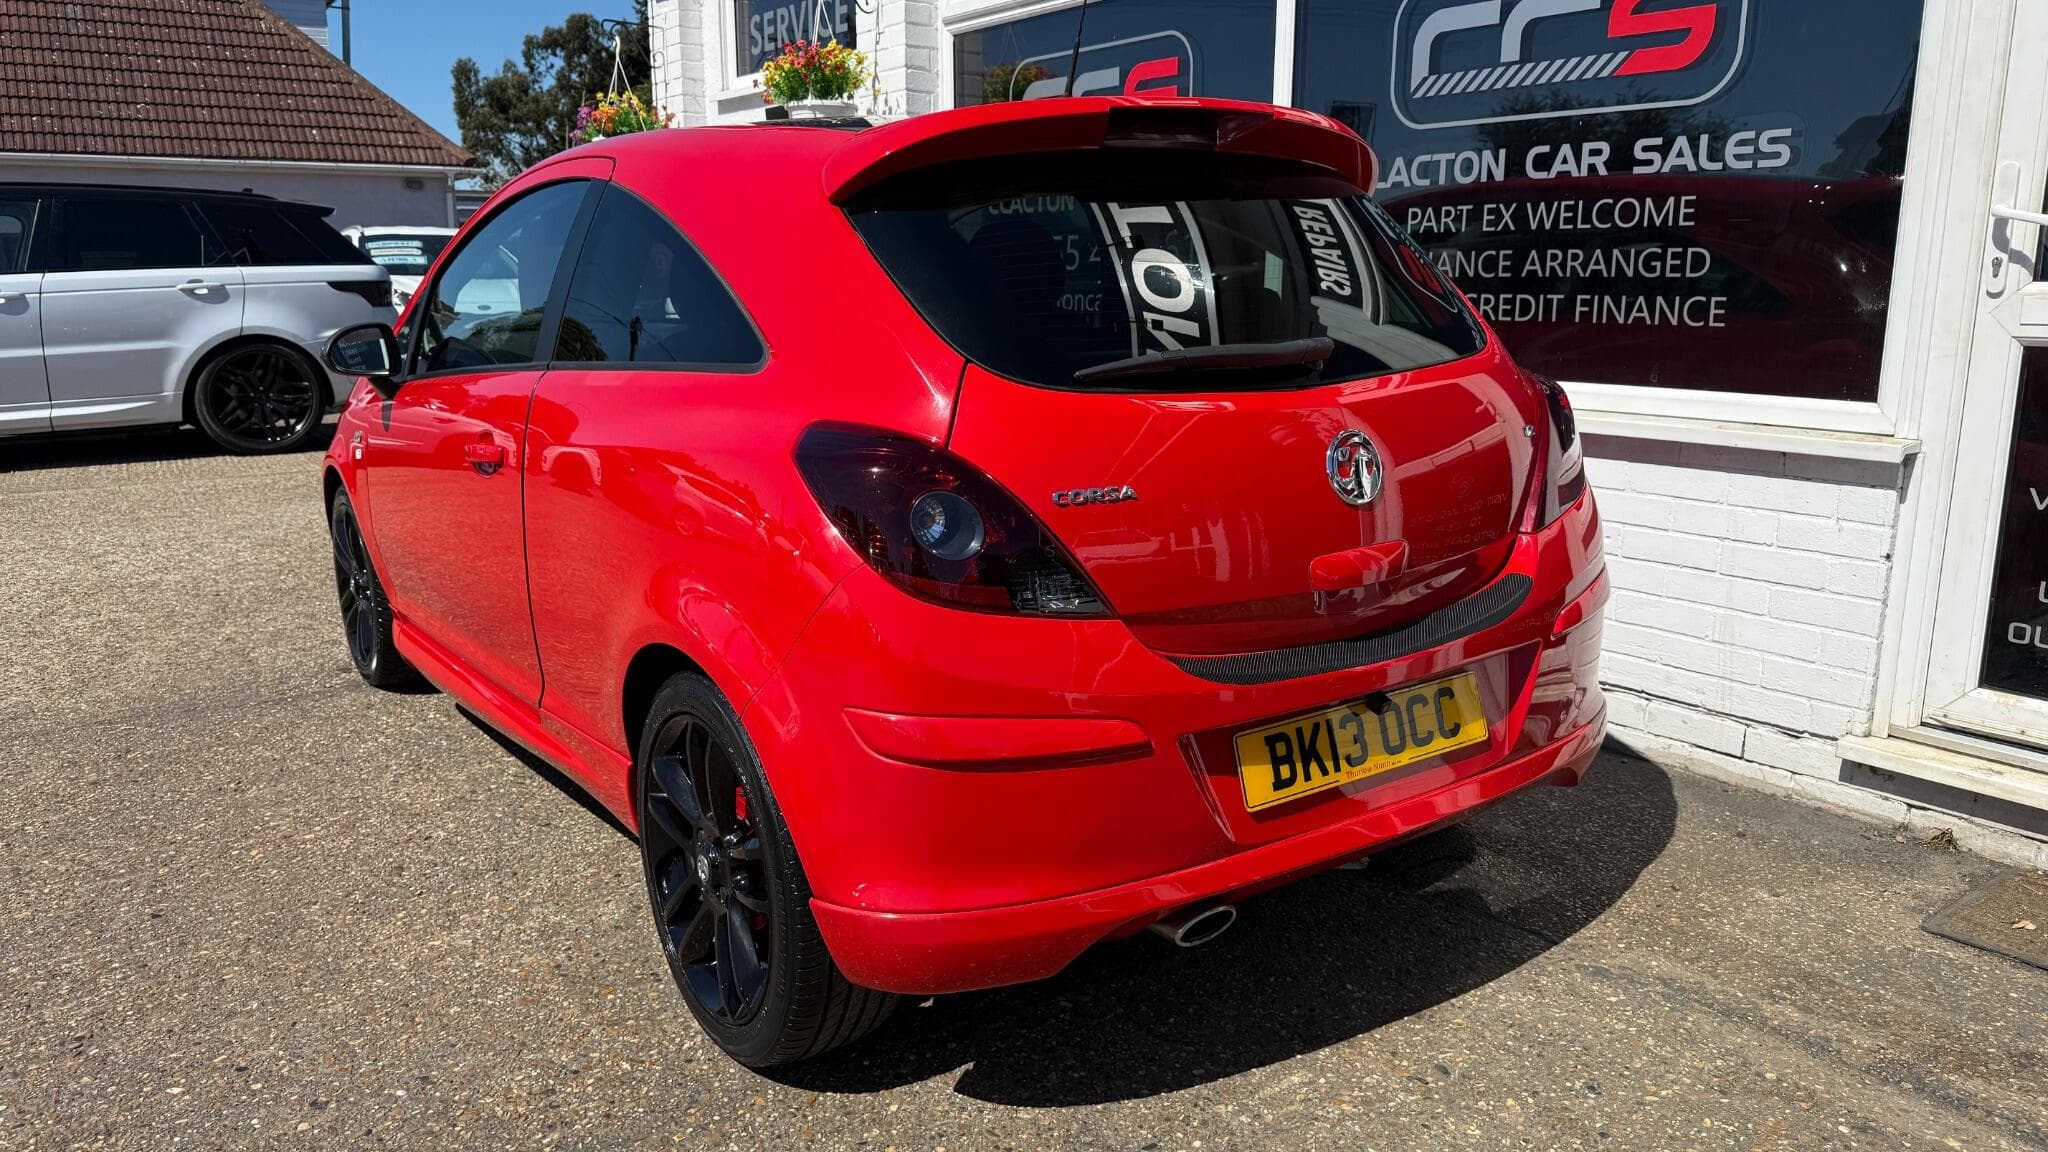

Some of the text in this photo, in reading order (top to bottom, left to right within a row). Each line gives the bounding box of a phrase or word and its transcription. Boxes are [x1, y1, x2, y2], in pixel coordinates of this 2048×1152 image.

[750, 0, 848, 55] SERVICE
[1376, 128, 1792, 188] ACTON CAR SALES
[1407, 195, 1697, 234] PART EX WELCOME
[1429, 247, 1711, 278] ANCE ARRANGED
[1575, 294, 1727, 328] FINANCE
[1052, 485, 1138, 507] CORSA
[1264, 687, 1461, 793] BK13 OCC
